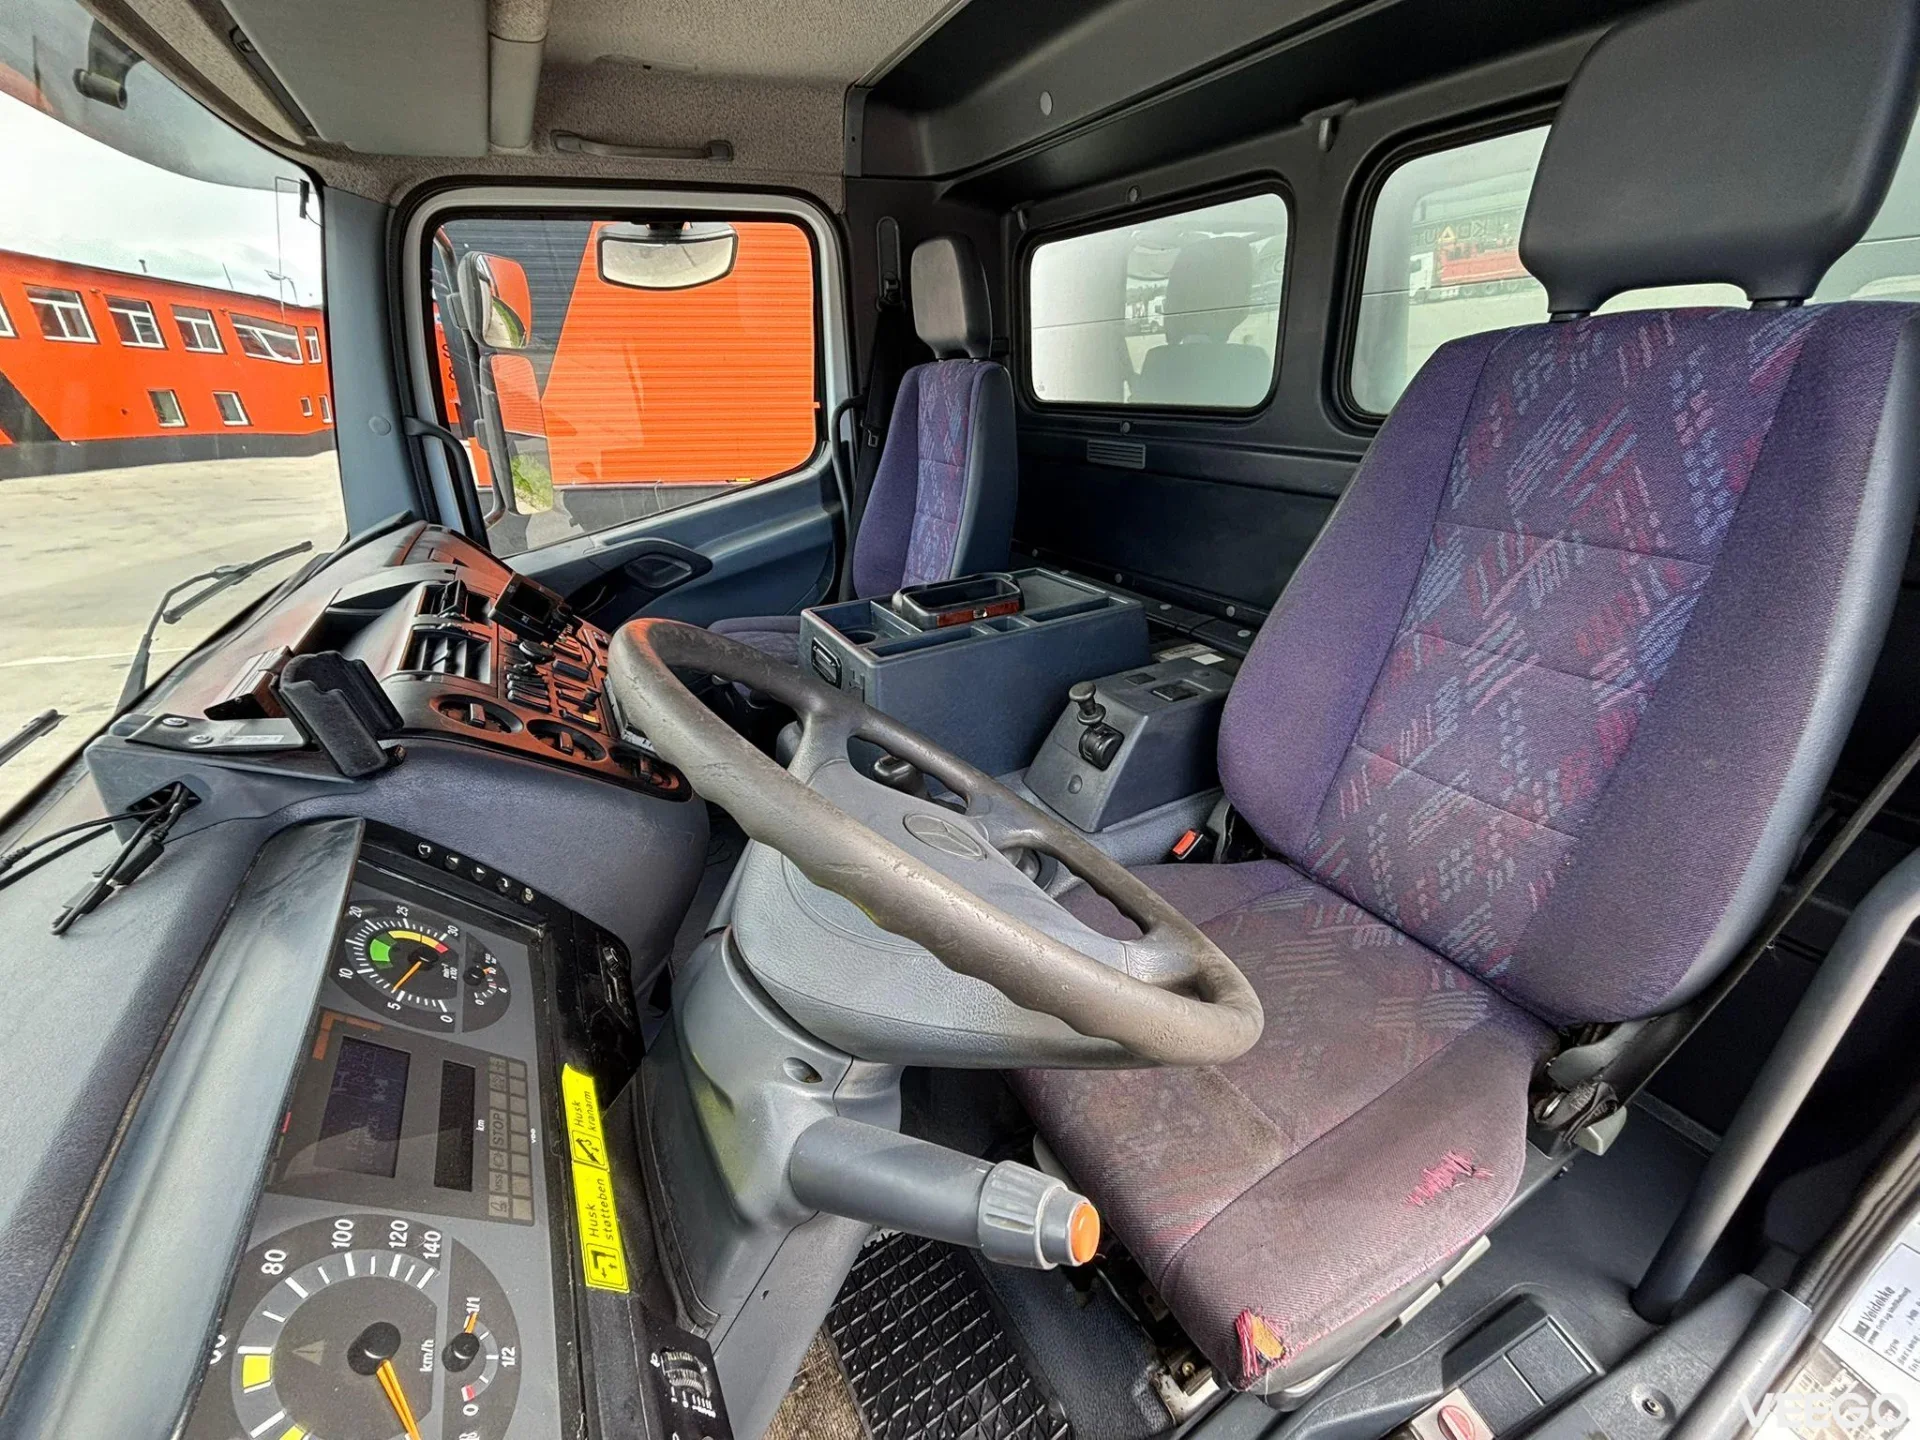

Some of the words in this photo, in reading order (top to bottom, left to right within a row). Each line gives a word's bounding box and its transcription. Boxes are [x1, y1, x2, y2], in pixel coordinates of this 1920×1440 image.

[349, 906, 362, 918] 20
[396, 905, 409, 917] 25
[447, 924, 459, 937] 30
[338, 967, 354, 979] 10
[387, 1001, 401, 1011] 5
[440, 1014, 453, 1023] 0
[571, 1100, 583, 1128] Husk
[586, 1090, 598, 1132] kranarm
[492, 1112, 505, 1145] STOP
[587, 1204, 600, 1238] Husk
[597, 1178, 614, 1241] støtteben
[331, 1219, 355, 1249] 100
[388, 1220, 410, 1249] 120
[423, 1230, 442, 1260] 140
[260, 1249, 287, 1276] 80
[466, 1296, 480, 1313] 1/1
[419, 1338, 435, 1373] km/h
[501, 1346, 516, 1368] 1/2
[462, 1403, 479, 1417] 0
